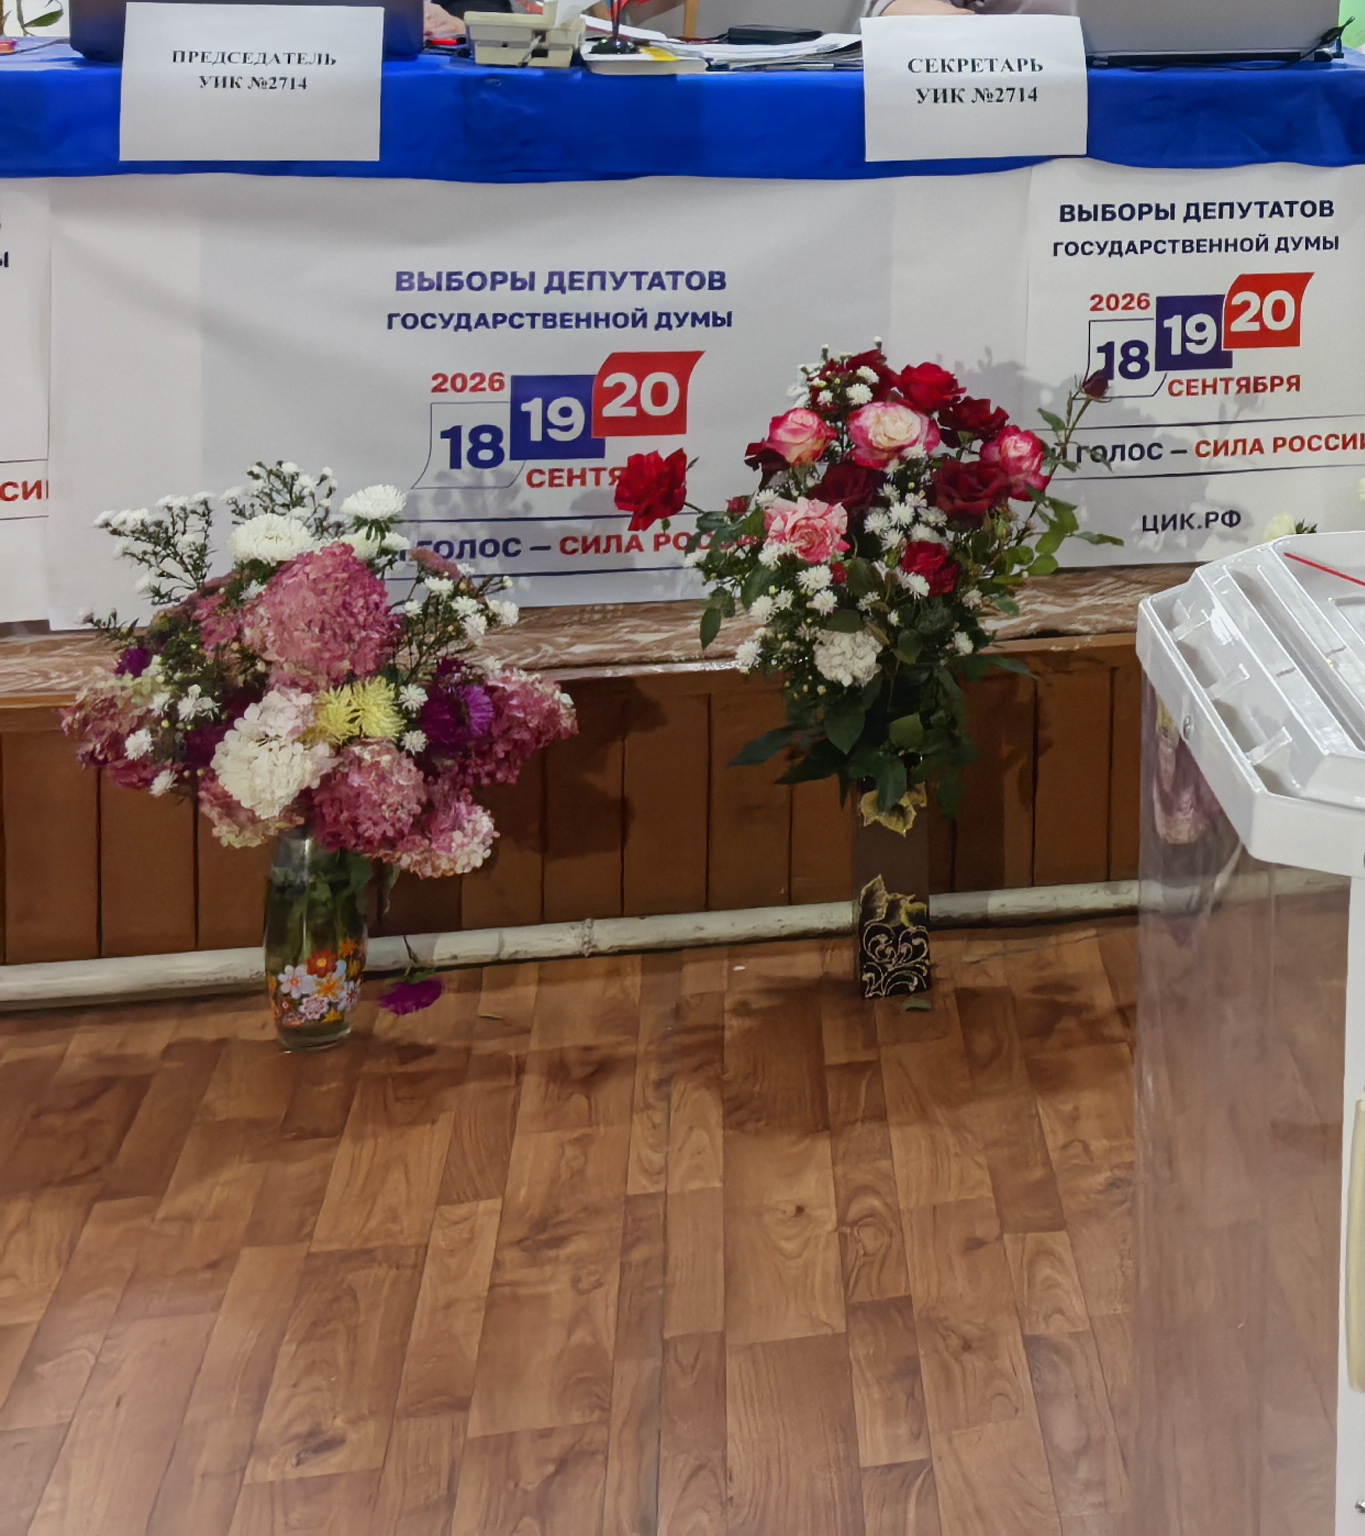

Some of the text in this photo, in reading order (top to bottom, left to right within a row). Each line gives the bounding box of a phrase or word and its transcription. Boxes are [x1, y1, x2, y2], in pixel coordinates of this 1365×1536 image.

[172, 49, 337, 67] ПРЕДСЕДАТЕЛЬ
[907, 56, 1044, 75] СЕКРЕТАРЬ
[199, 74, 308, 91] УИК №2714
[915, 85, 1039, 105] УИК №2714
[1059, 199, 1335, 223] ВЫБОРЫ ДЕПУТАТОВ
[1052, 234, 1340, 257] ГОСУДАРСТВЕННОЙ ДУМЫ
[395, 269, 727, 295] ВЫБОРЫ ДЕПУТАТОВ
[1089, 293, 1151, 312] 2026
[386, 306, 733, 332] ГОСУДАРСТВЕННОЙ ДУМЫ
[1096, 290, 1296, 381] 18 19 20
[430, 372, 506, 394] 2026
[1167, 374, 1301, 397] СЕНТЯБРЯ
[439, 371, 680, 471] 18 19 20
[1076, 442, 1163, 464] ГОЛОС
[1195, 437, 1264, 458] СИЛА
[526, 466, 622, 489] СЕНТЯ
[1141, 509, 1241, 533] ЦИК.РФ
[559, 533, 645, 556] СИЛА
